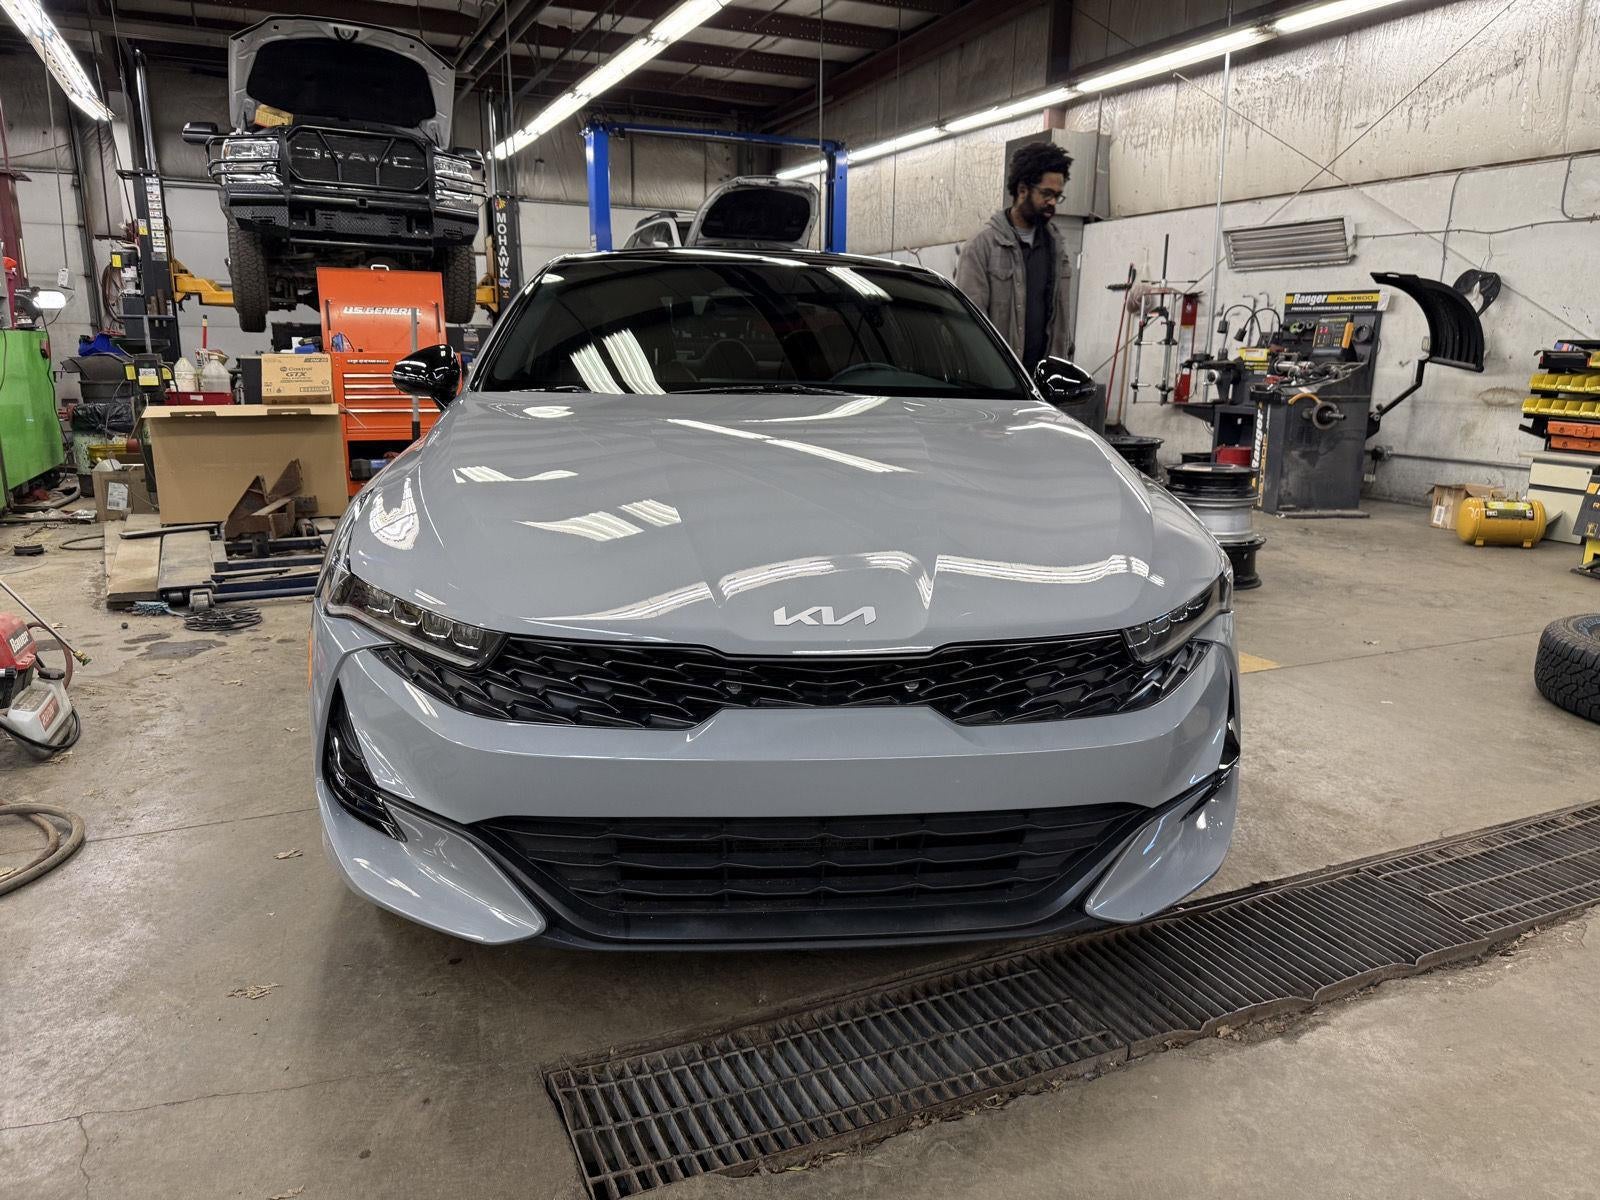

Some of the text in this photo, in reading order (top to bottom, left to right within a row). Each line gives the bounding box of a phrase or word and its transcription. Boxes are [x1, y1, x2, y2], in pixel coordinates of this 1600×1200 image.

[496, 213, 510, 278] MOHAWK
[1293, 293, 1328, 305] Ranger
[1251, 408, 1264, 469] Ranger
[773, 606, 877, 626] KIA
[9, 630, 29, 653] Bauer
